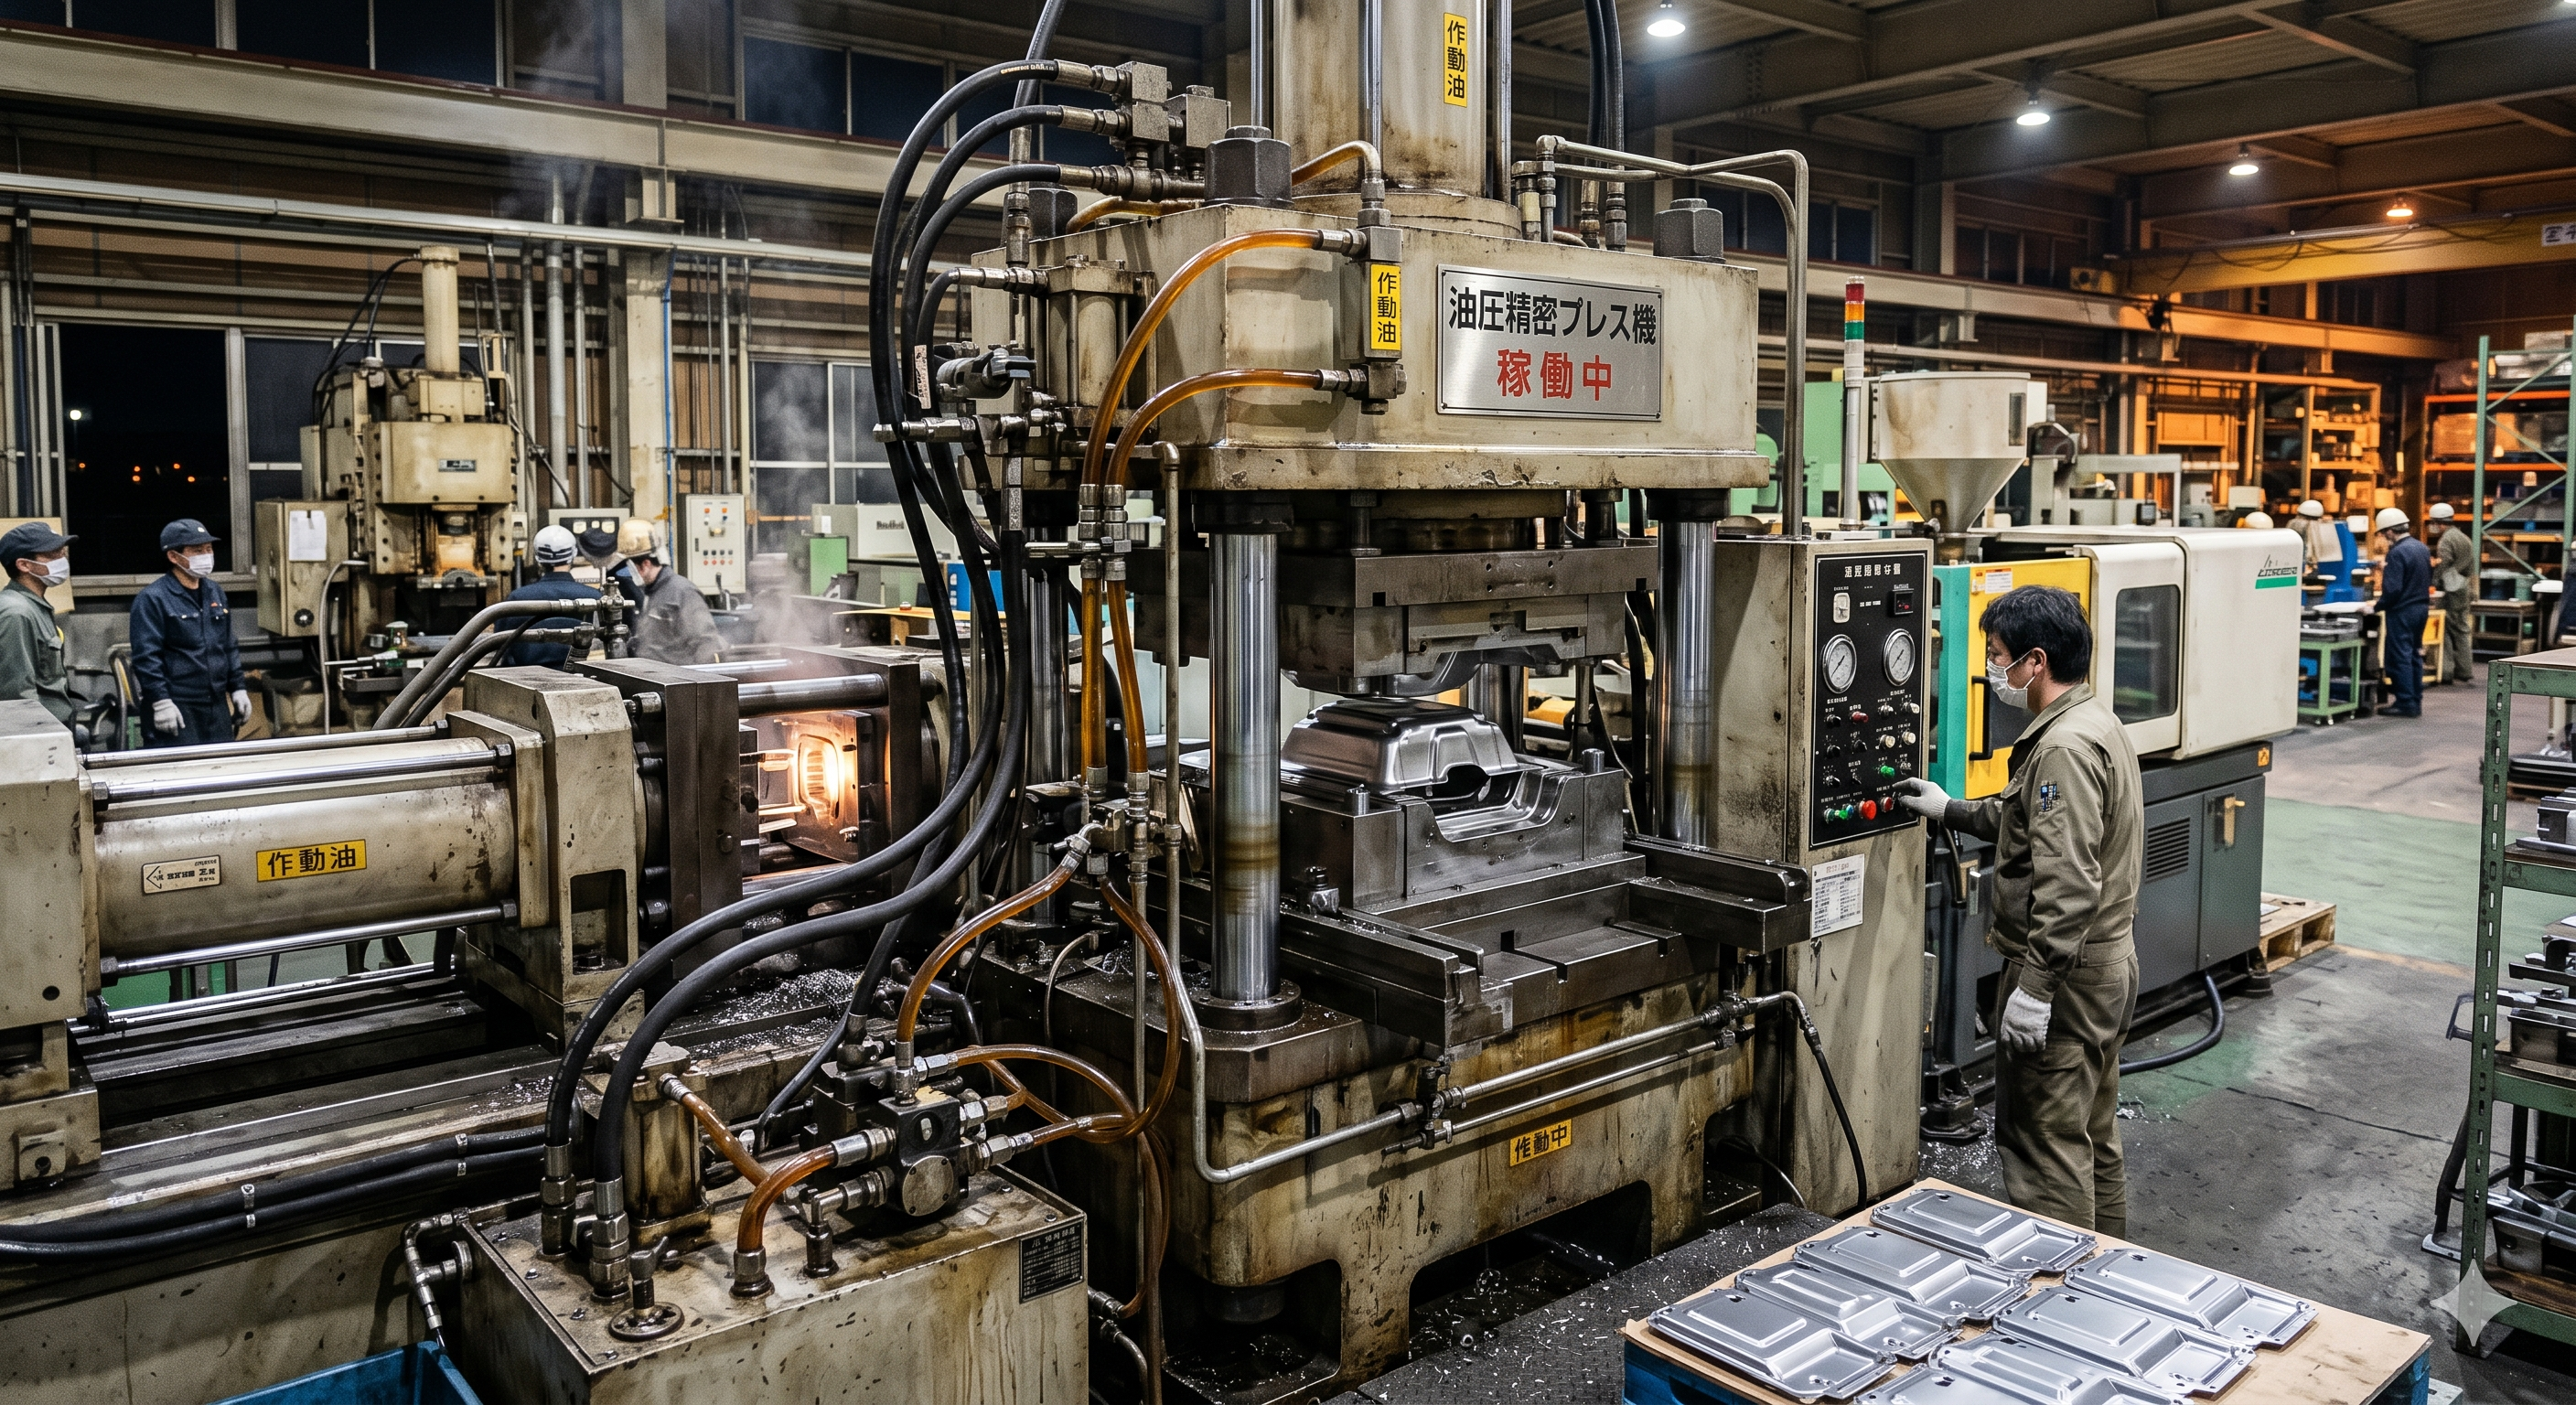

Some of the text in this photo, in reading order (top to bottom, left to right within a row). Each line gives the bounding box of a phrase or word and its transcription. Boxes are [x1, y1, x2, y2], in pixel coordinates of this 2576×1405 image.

[1447, 20, 1465, 99] 作動油
[1377, 272, 1397, 343] 作動油
[1448, 285, 1657, 345] 油圧精密プレス機
[1497, 349, 1612, 401] 稼働中
[267, 844, 356, 877] 作動油
